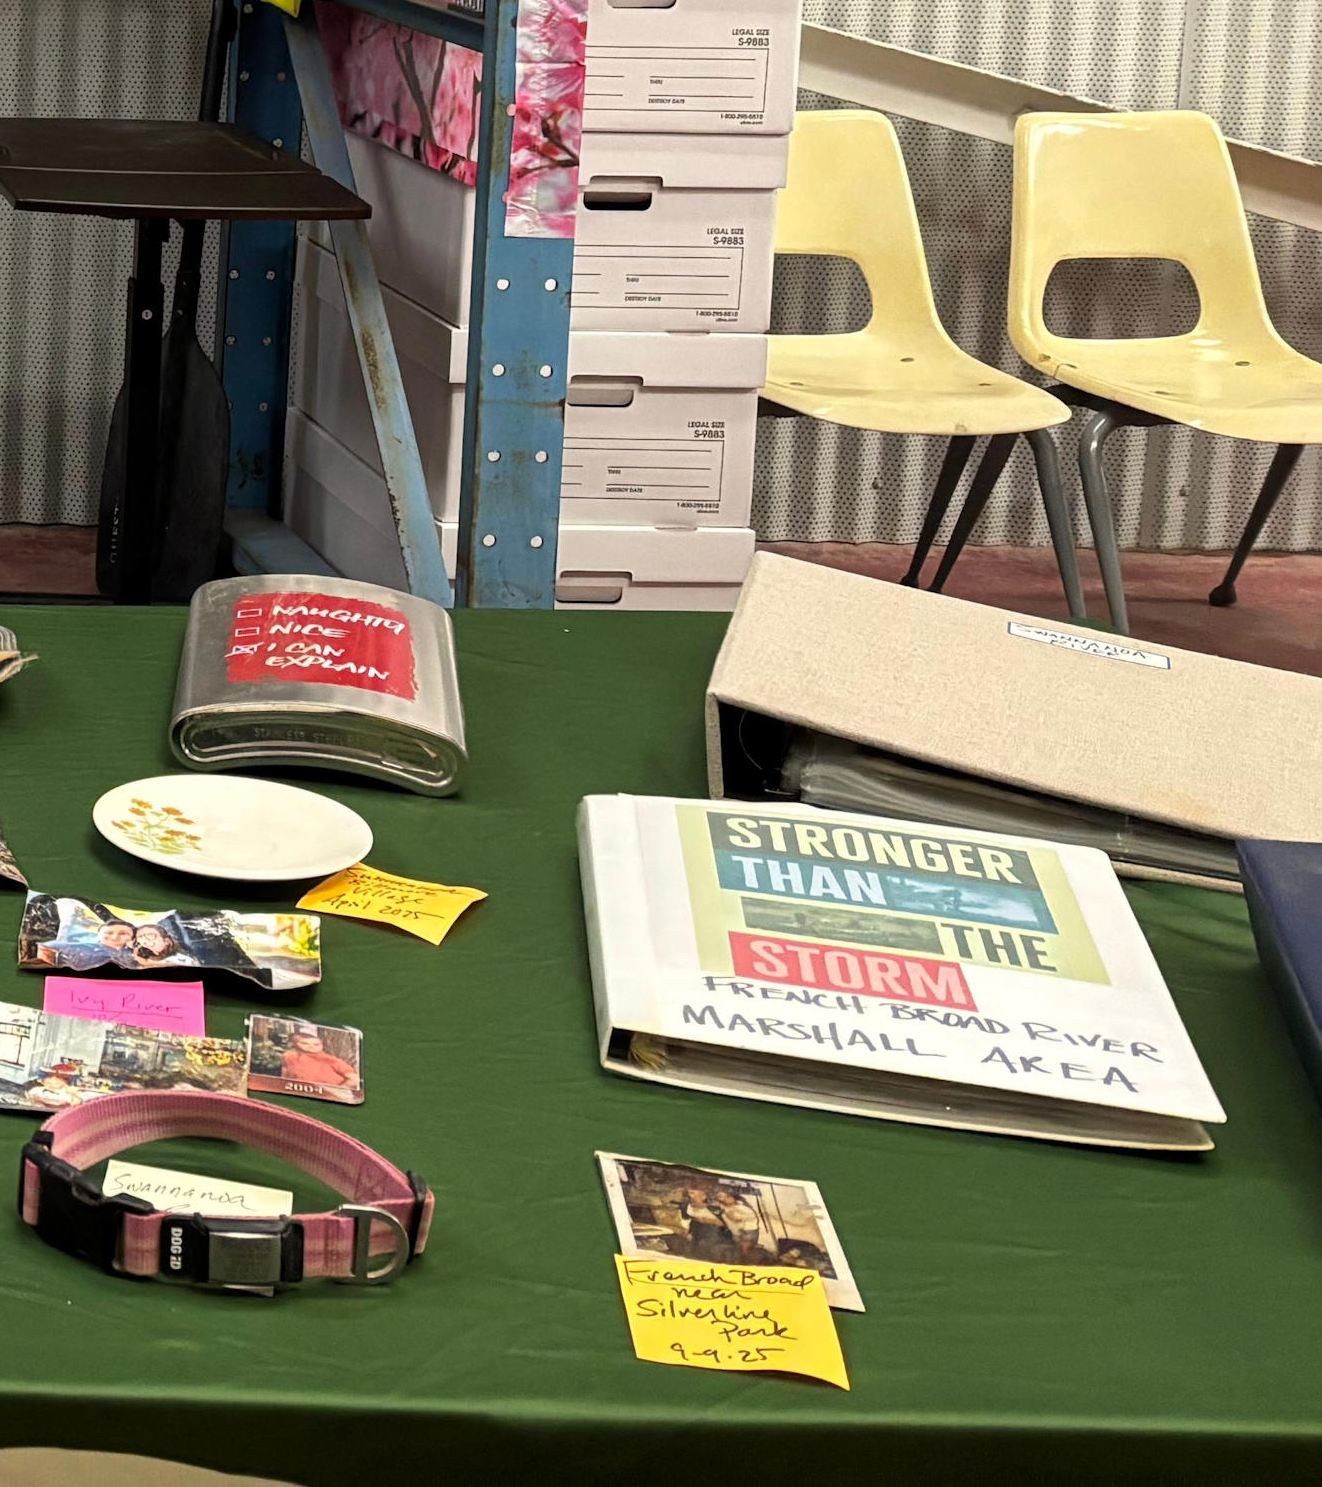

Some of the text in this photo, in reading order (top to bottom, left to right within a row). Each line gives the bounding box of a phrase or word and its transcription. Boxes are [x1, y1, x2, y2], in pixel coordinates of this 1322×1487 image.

[739, 38, 769, 46] S-9883
[713, 237, 744, 245] S-9883
[694, 430, 725, 438] S-9883
[269, 621, 350, 638] NICE
[272, 605, 406, 635] NAUGHTY
[288, 643, 345, 657] CAN
[265, 655, 389, 680] EXPLAIN
[726, 817, 1022, 884] STRONGER
[733, 856, 888, 905] THAN
[940, 923, 1057, 971] THE
[749, 940, 970, 1005] STORM
[702, 976, 1164, 1063] FRENCH BROAD RIVER
[682, 1004, 1138, 1093] MARSHALL AREA
[729, 1269, 814, 1290] Broad
[673, 1287, 751, 1300] near
[711, 1321, 797, 1341] Park
